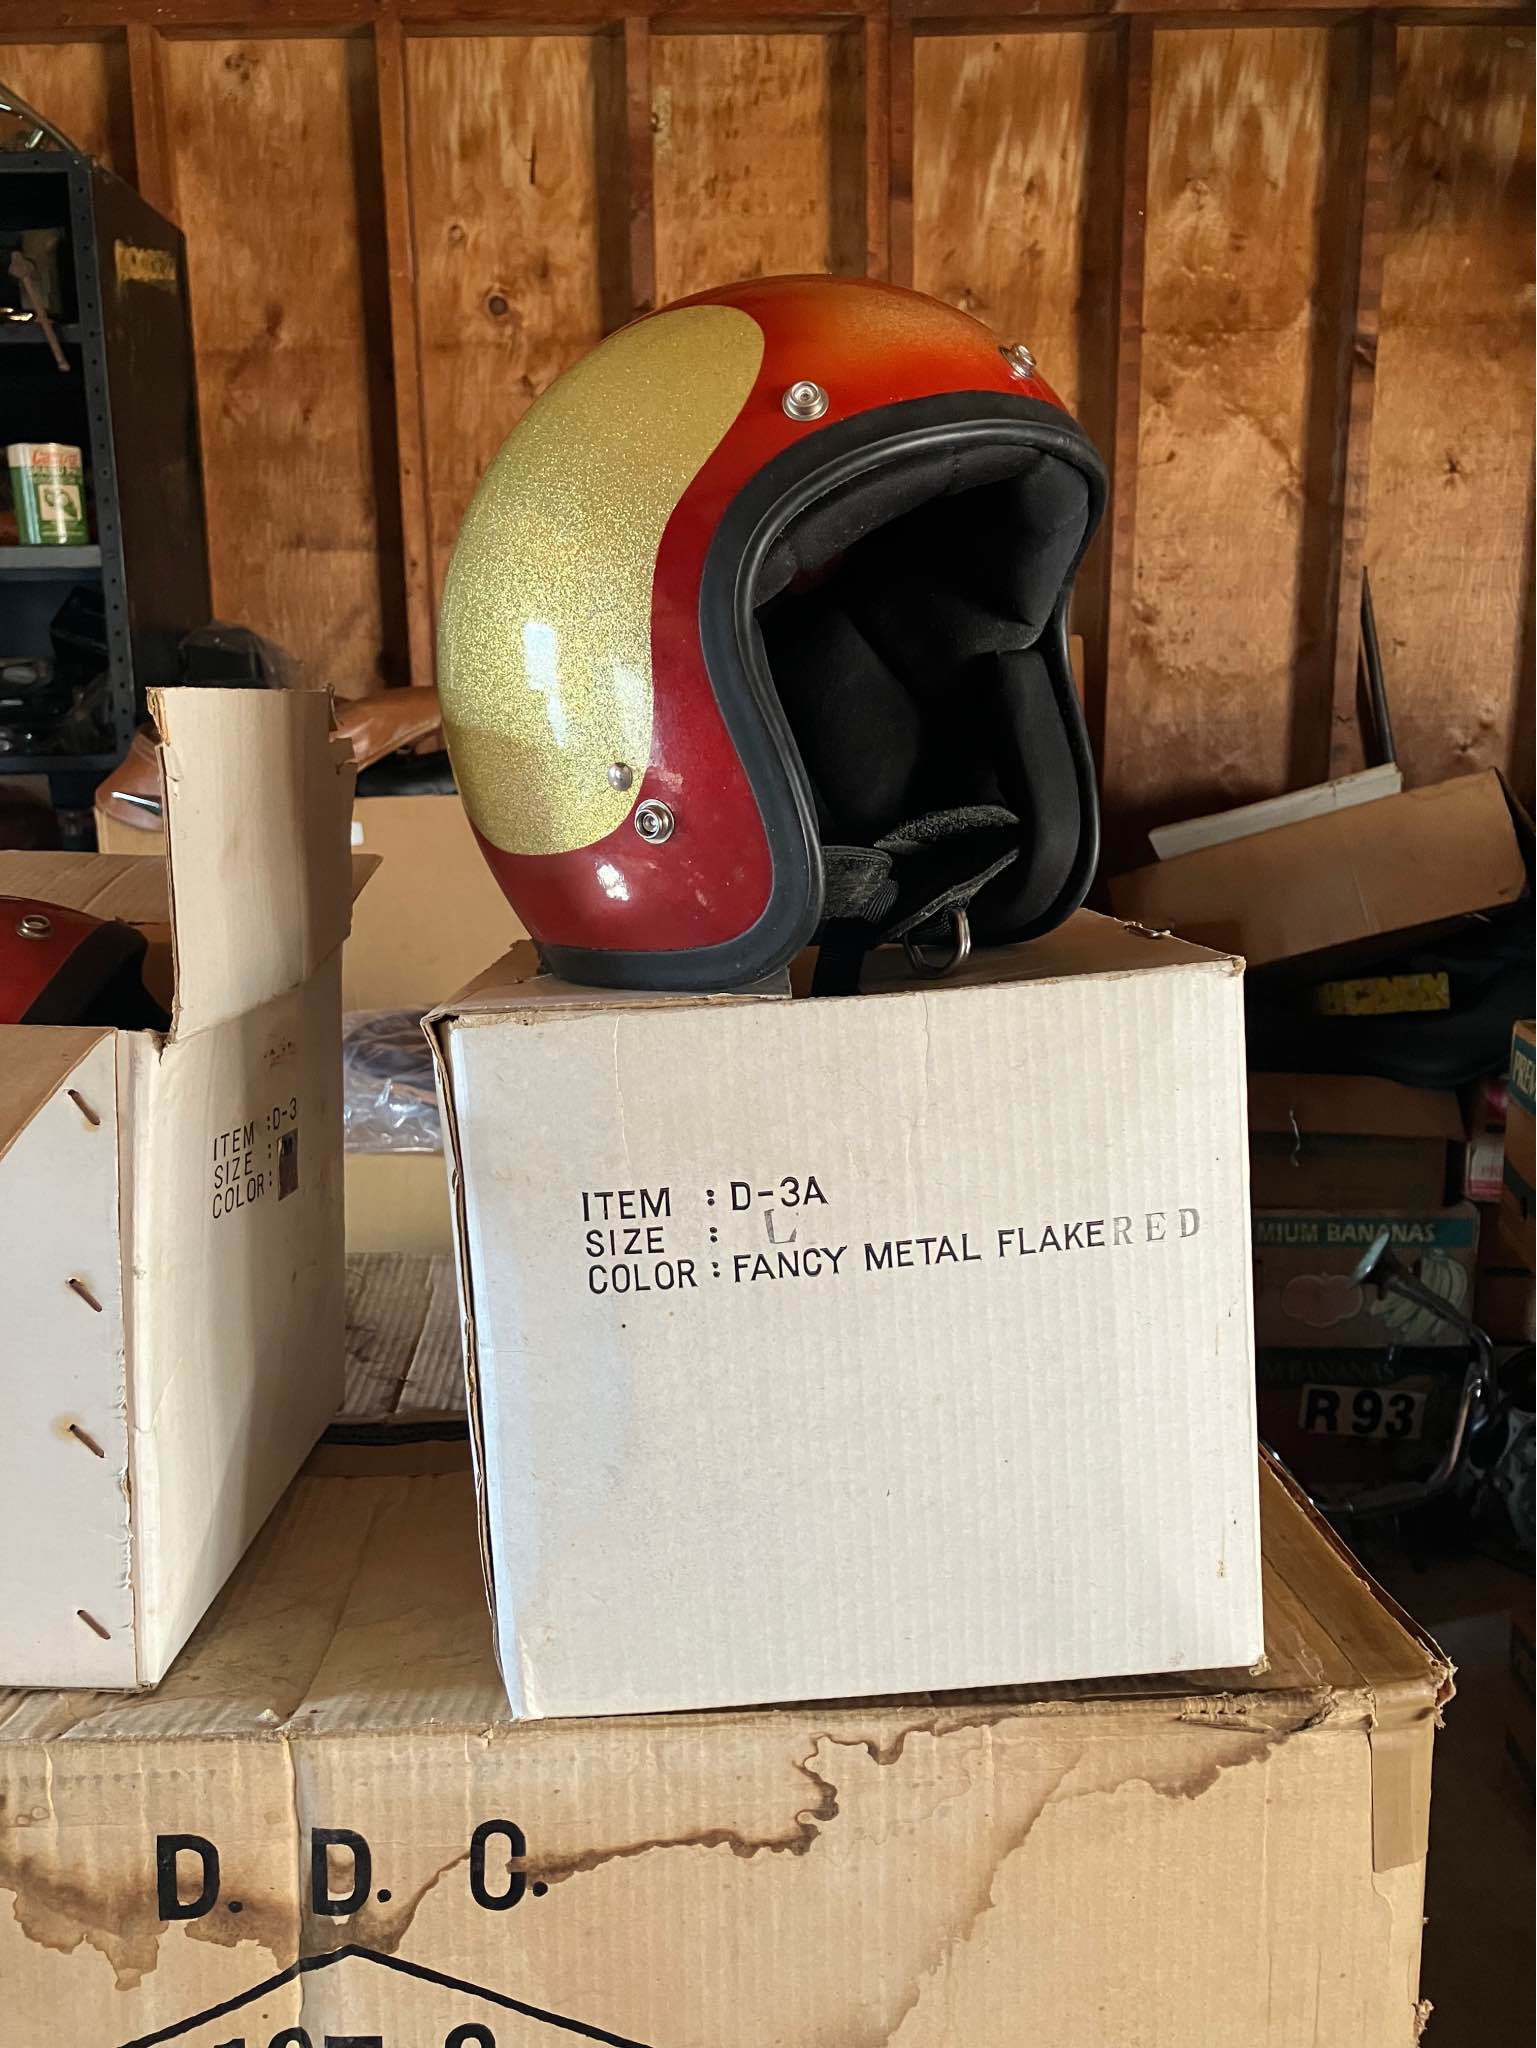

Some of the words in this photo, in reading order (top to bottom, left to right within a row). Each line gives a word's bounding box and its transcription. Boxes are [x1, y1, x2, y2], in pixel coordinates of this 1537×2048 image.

[213, 1121, 255, 1161] ITEM
[214, 1151, 253, 1189] SIZE
[212, 1173, 265, 1219] COLOR
[581, 1187, 672, 1222] ITEM
[730, 1176, 829, 1211] D-3A
[585, 1226, 665, 1258] SIZE
[764, 1208, 798, 1244] L
[588, 1259, 698, 1294] COLOR
[733, 1245, 847, 1283] FANCY
[864, 1233, 982, 1272] METAL
[998, 1219, 1106, 1258] FLAKE
[1112, 1208, 1200, 1246] RED
[1327, 1222, 1436, 1243] BANANAS
[1306, 1390, 1340, 1431] R
[1352, 1389, 1415, 1437] 93
